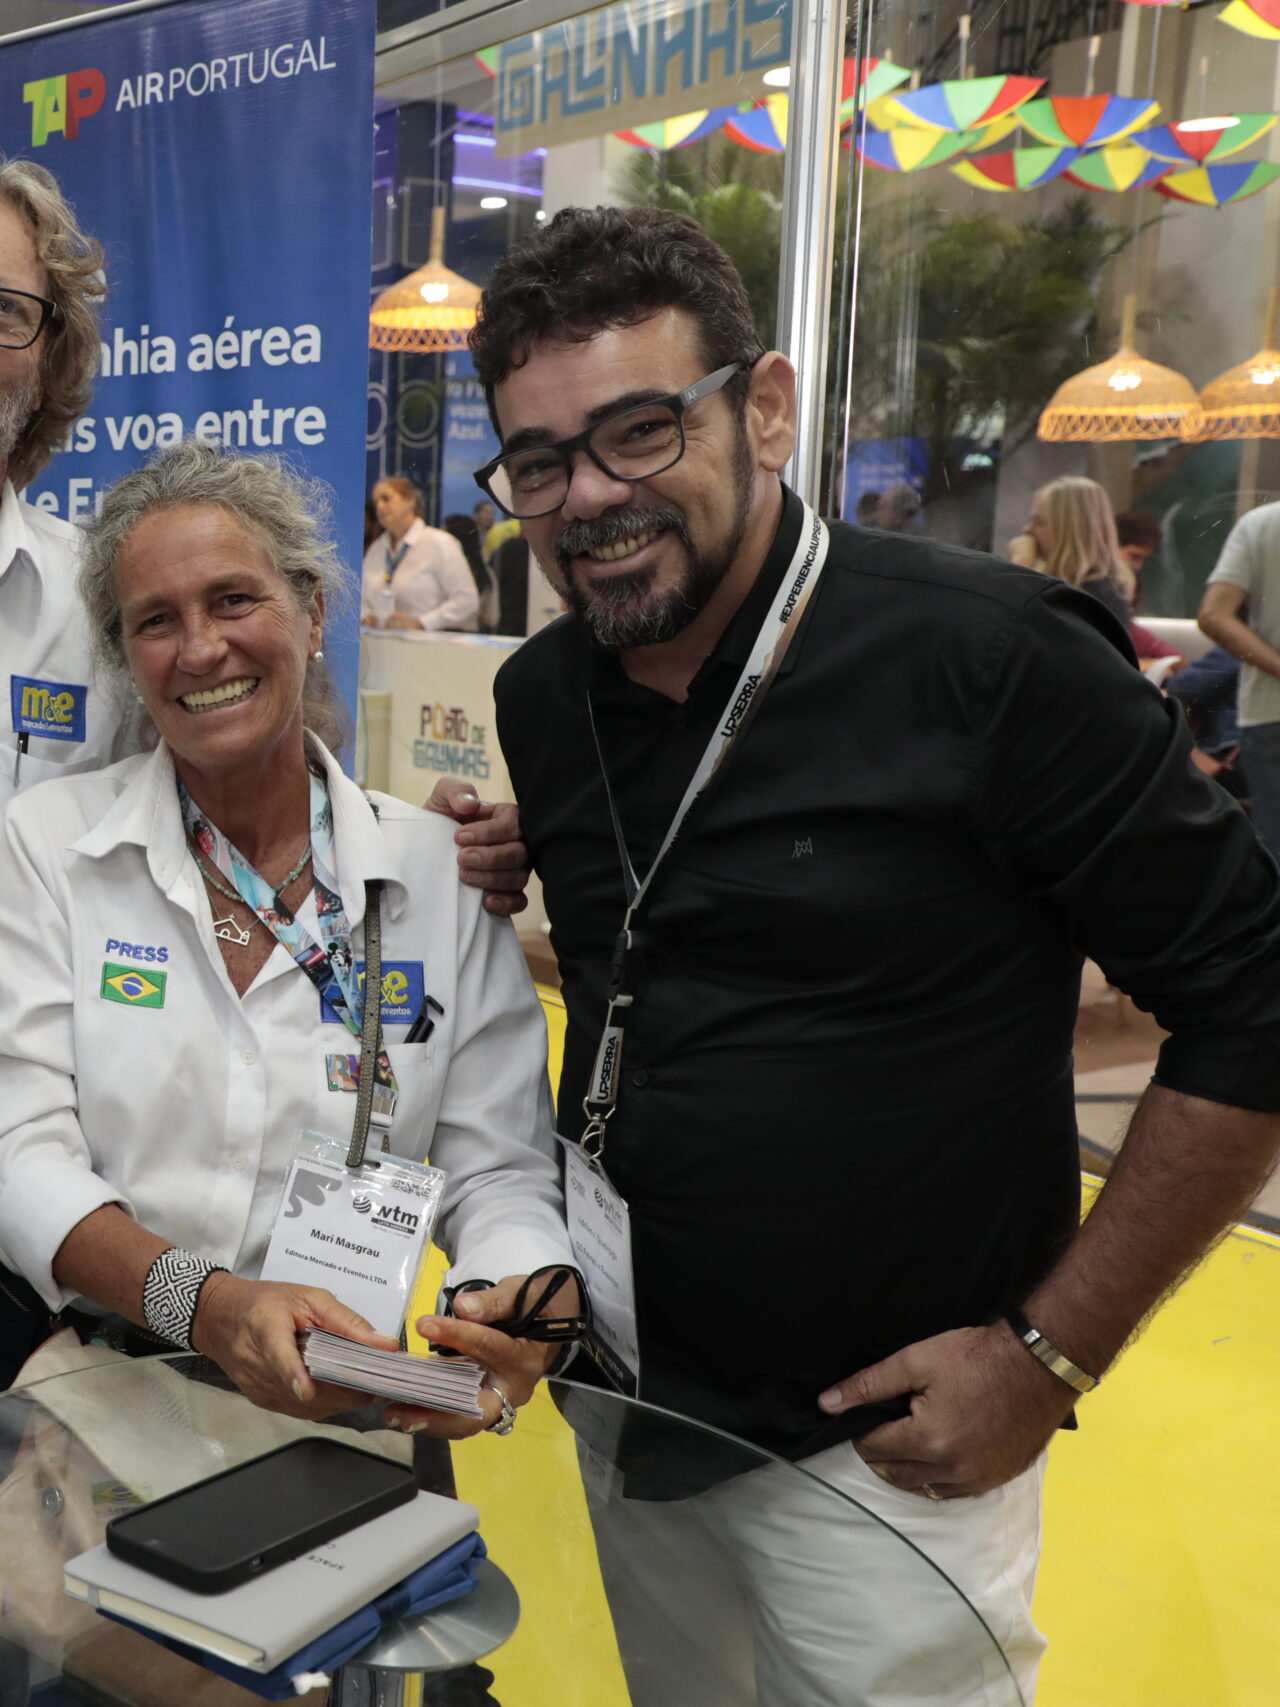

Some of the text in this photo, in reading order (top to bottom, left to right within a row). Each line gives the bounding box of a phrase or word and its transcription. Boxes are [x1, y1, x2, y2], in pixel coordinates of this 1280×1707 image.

[23, 68, 107, 147] TAP
[187, 316, 321, 372] aérea
[104, 412, 183, 450] voa
[195, 399, 327, 447] entre
[21, 686, 75, 723] m&e
[421, 703, 486, 745] PORTO DE
[721, 674, 762, 738] UPSERRA
[105, 938, 169, 963] PRESS
[597, 1035, 617, 1100] UPSERRA
[310, 1228, 380, 1258] Mari Masgrau
[285, 1248, 308, 1261] Editora
[309, 1255, 337, 1270] Mercado
[343, 1266, 369, 1280] Eventos
[369, 1274, 388, 1286] LTDA
